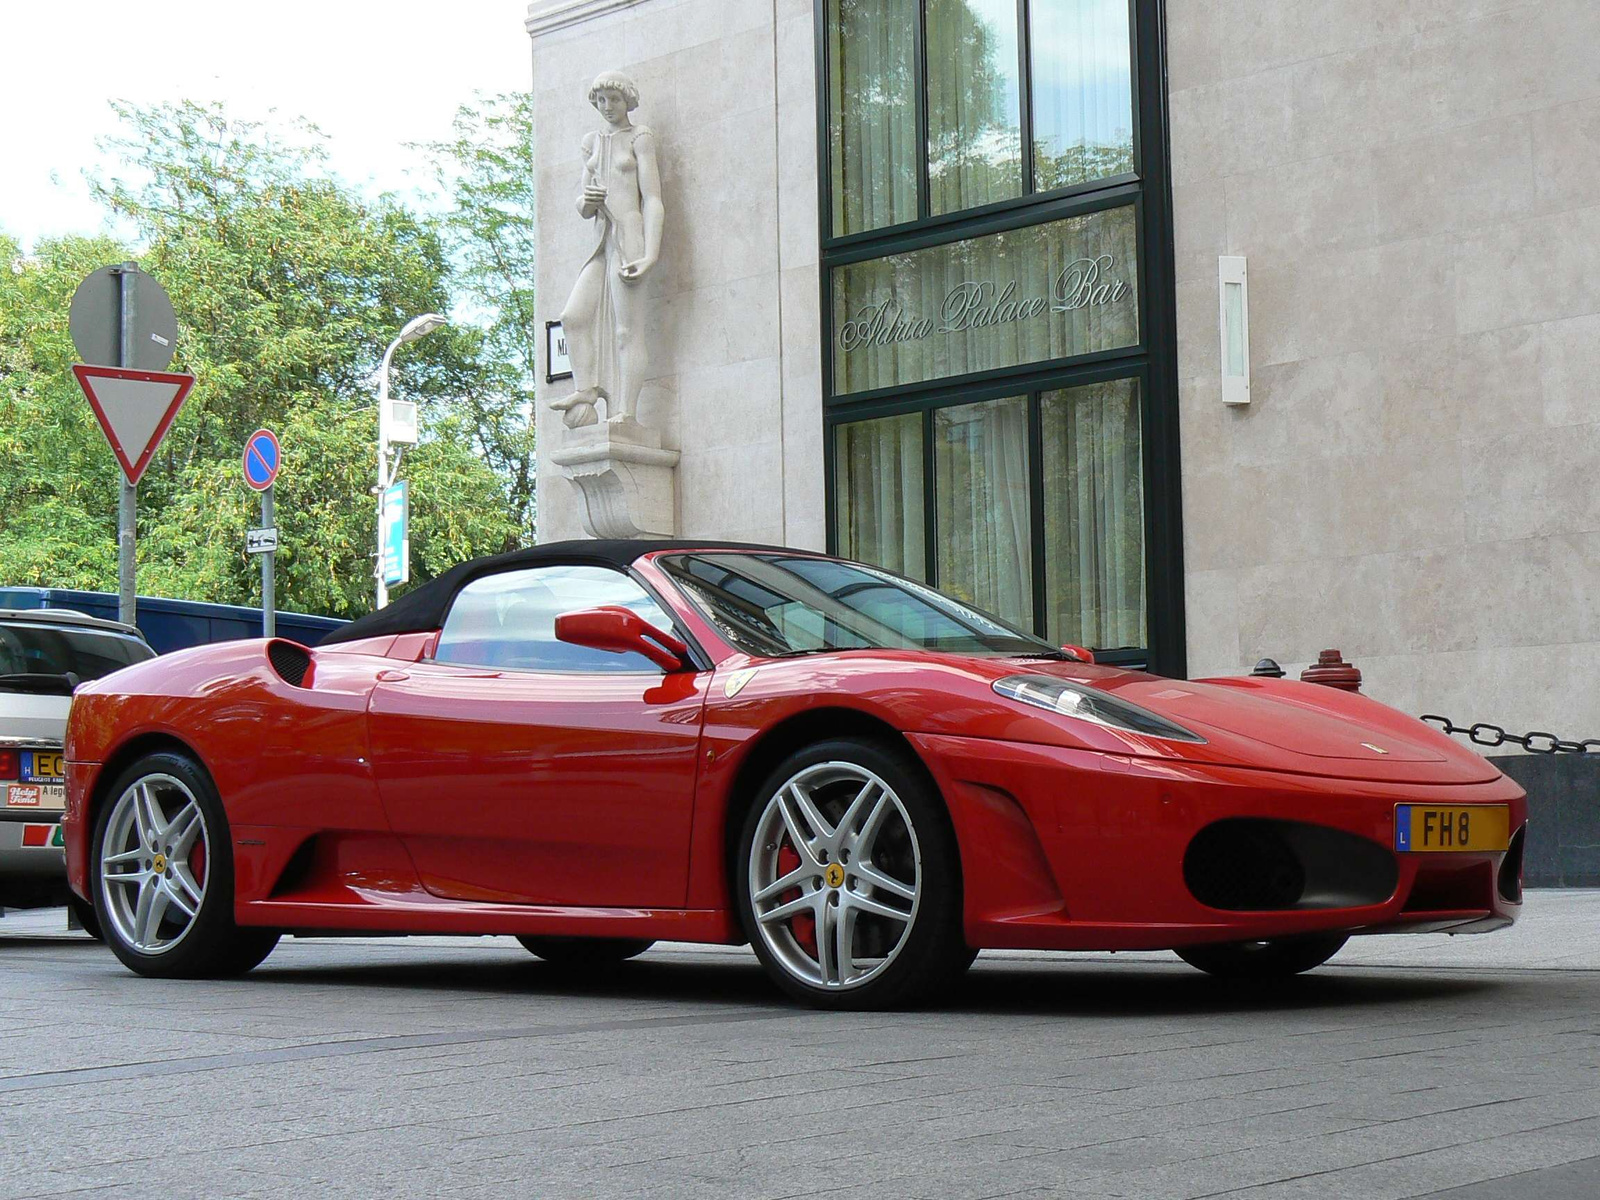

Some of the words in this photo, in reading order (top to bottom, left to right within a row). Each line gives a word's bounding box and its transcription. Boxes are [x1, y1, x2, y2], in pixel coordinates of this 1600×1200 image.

[839, 298, 934, 352] Adria
[936, 279, 1046, 334] Palace
[1050, 254, 1127, 313] Bar
[24, 766, 31, 775] H
[1399, 831, 1406, 844] L
[1423, 811, 1470, 846] FH8
